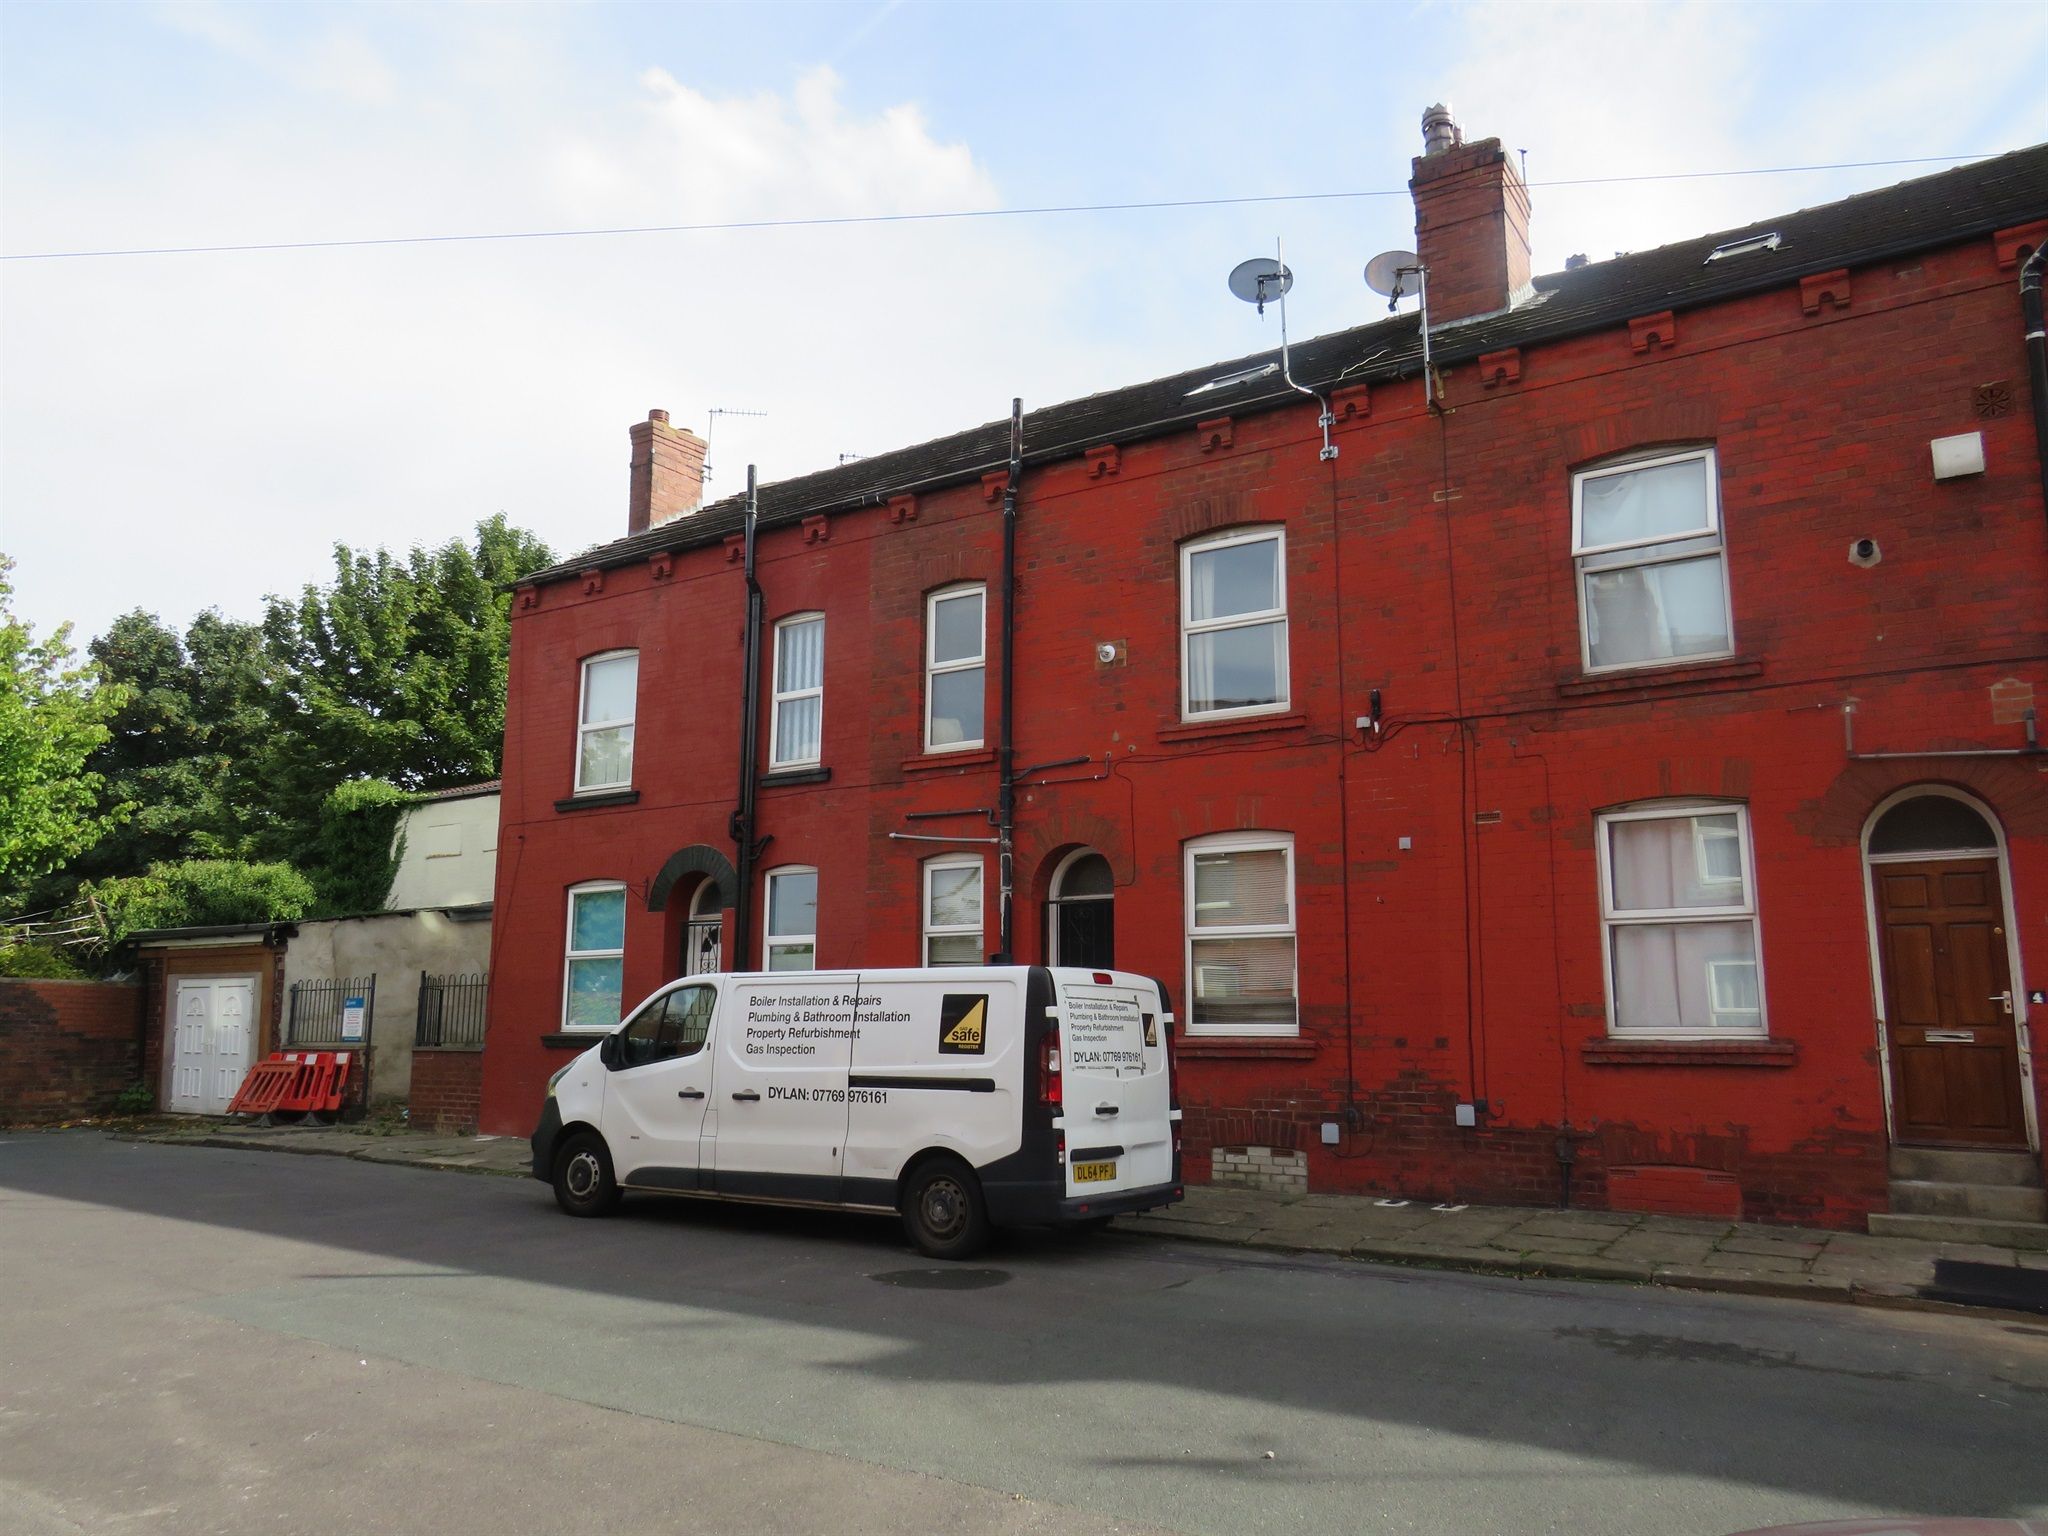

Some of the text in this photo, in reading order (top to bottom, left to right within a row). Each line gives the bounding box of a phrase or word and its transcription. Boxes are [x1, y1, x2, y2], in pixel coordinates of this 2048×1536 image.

[749, 995, 882, 1008] Boiler Installation & Repairs
[1084, 1002, 1108, 1010] Installation
[748, 1011, 911, 1024] Plumbing & Bathroom Installation
[1070, 1013, 1093, 1021] Plumbing
[1098, 1013, 1119, 1021] Bathroom
[746, 1027, 861, 1040] Property Refurbishment
[951, 1028, 980, 1041] safe
[1071, 1024, 1092, 1032] Property
[746, 1044, 816, 1056] Gas Inspection
[1073, 1052, 1141, 1062] DYLAN: 07769 976161
[768, 1087, 887, 1104] DYLAN: 07769 976161
[1077, 1165, 1097, 1180] DL64
